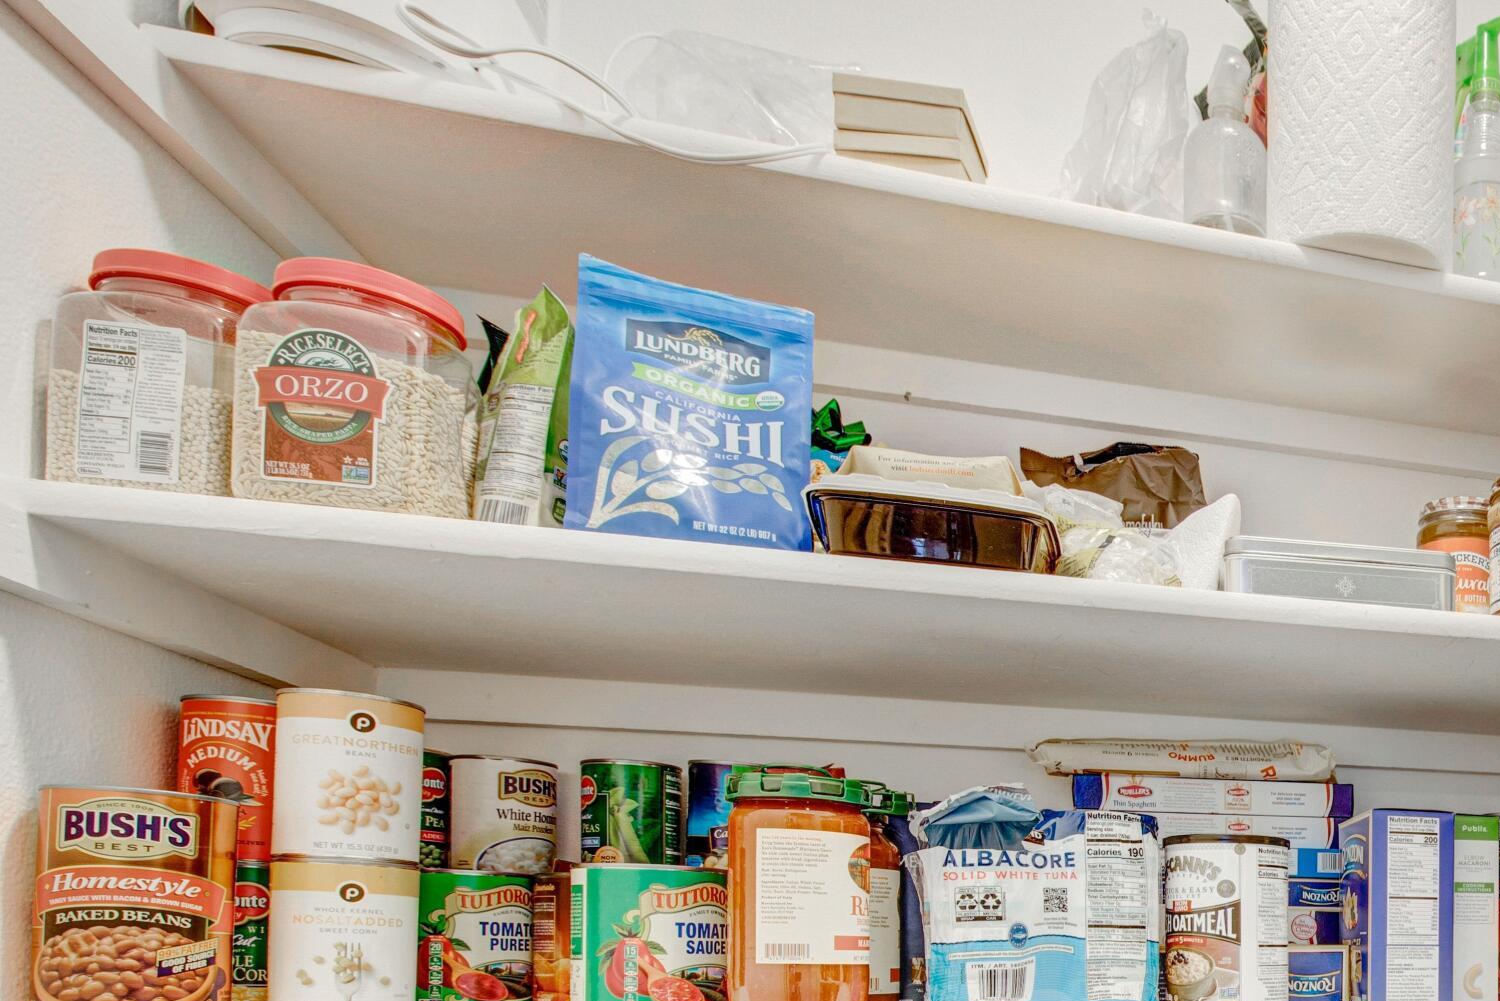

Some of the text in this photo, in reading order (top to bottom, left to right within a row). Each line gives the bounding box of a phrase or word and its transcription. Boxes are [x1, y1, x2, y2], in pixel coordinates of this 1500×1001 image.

[277, 333, 370, 372] RICESELECT
[635, 330, 760, 377] LUNDBERG
[275, 374, 369, 403] ORZO
[645, 369, 750, 408] ORGANIC
[655, 391, 741, 422] CALIFORNIA
[601, 386, 785, 468] SUSHI
[714, 453, 740, 461] RICE
[187, 747, 254, 772] MEDIUM
[345, 750, 376, 758] BEANS
[497, 808, 530, 821] White
[63, 810, 190, 848] BUSH'S
[94, 841, 155, 853] BEST
[942, 850, 1076, 868] ALBACORE
[52, 872, 202, 899] Homestyle
[943, 870, 1077, 881] SOLID WHITE TUNA
[55, 910, 193, 929] BAKED BEANS
[1172, 907, 1238, 940] OATMEAL
[490, 938, 530, 952] PUREE
[685, 940, 726, 956] SAUCE
